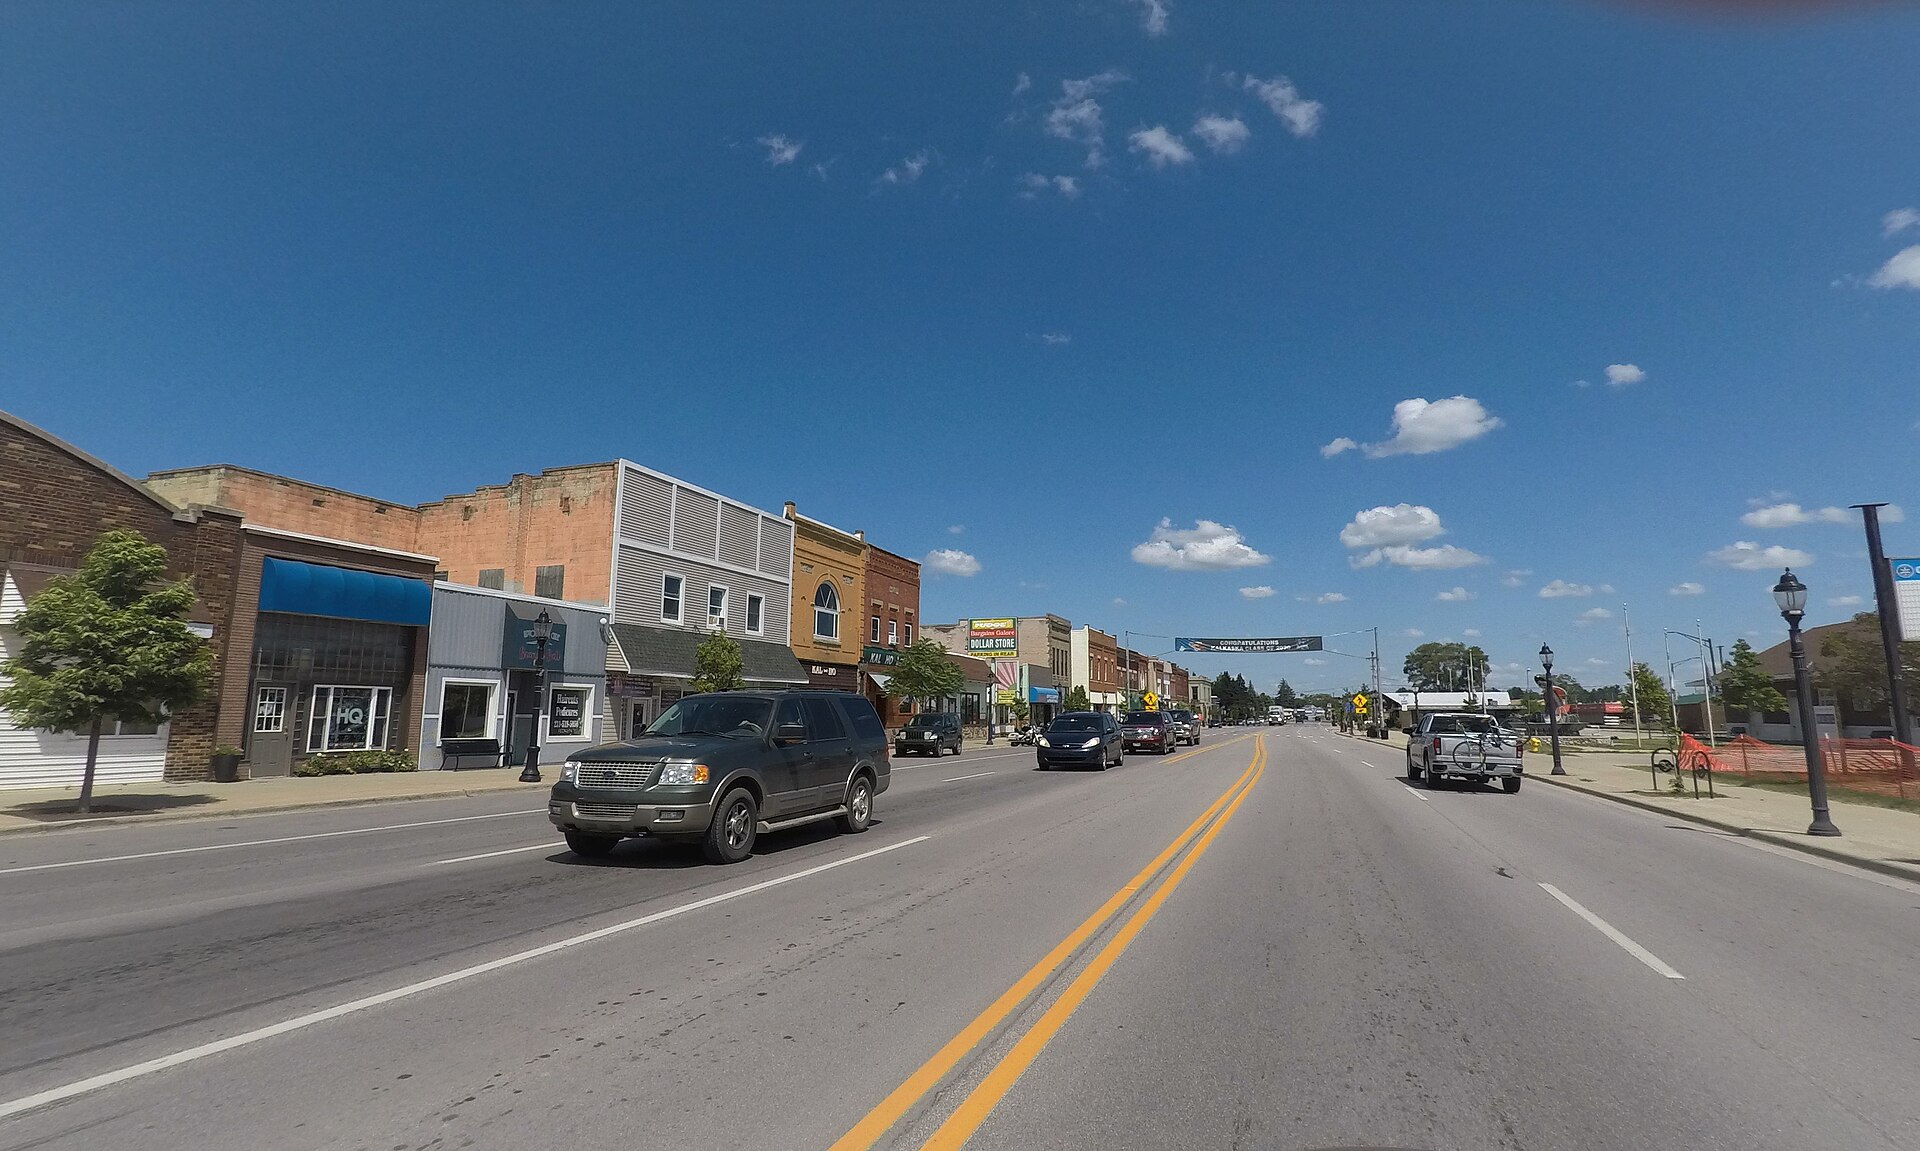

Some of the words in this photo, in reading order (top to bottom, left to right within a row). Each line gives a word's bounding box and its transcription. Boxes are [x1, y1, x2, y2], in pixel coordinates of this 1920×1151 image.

[971, 639, 993, 648] DOLLAR
[995, 638, 1015, 648] STORE
[870, 652, 882, 664] KAL
[884, 654, 895, 665] HO
[557, 694, 579, 704] Haircuts
[336, 707, 364, 725] HQ
[555, 707, 579, 716] Pedicures
